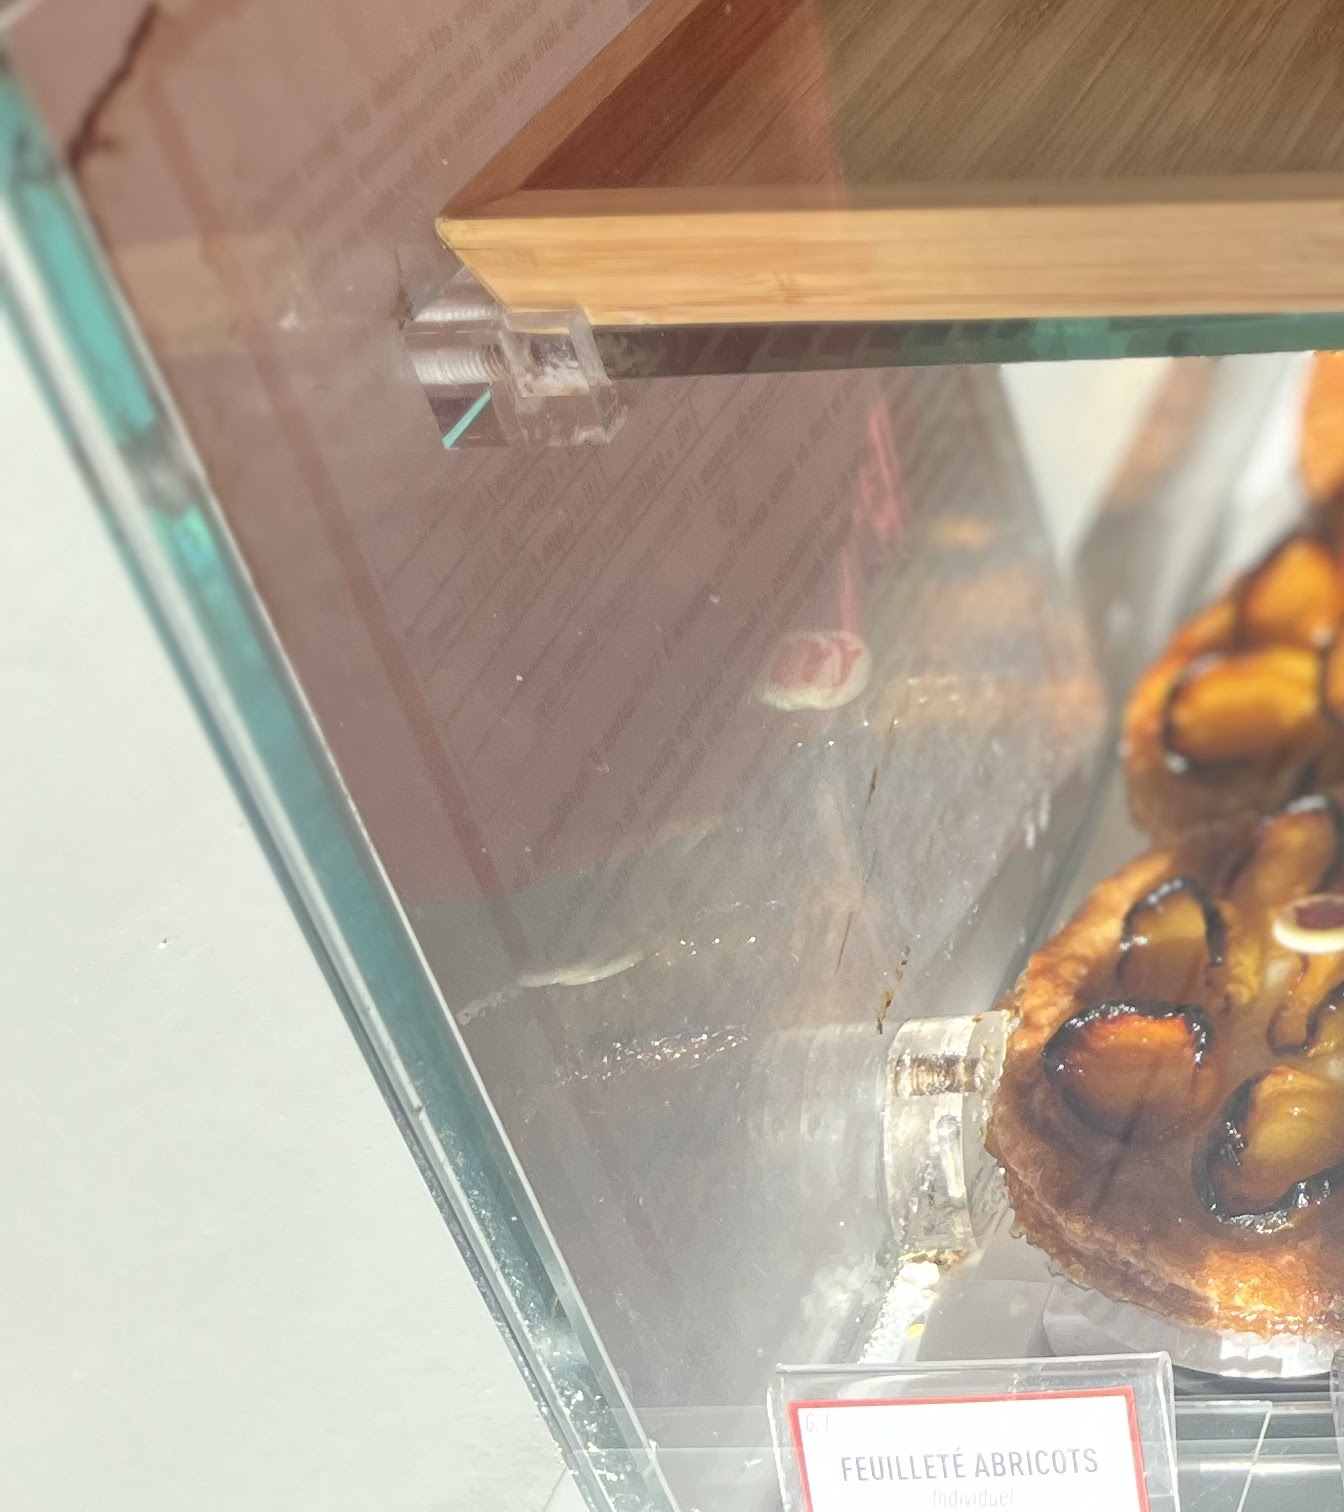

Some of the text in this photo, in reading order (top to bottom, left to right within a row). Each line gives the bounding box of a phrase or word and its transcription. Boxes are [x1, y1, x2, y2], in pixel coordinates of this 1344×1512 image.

[840, 1446, 1099, 1482] FEUILLETÉ ABRICOTS
[932, 1488, 1014, 1509] Individuel
